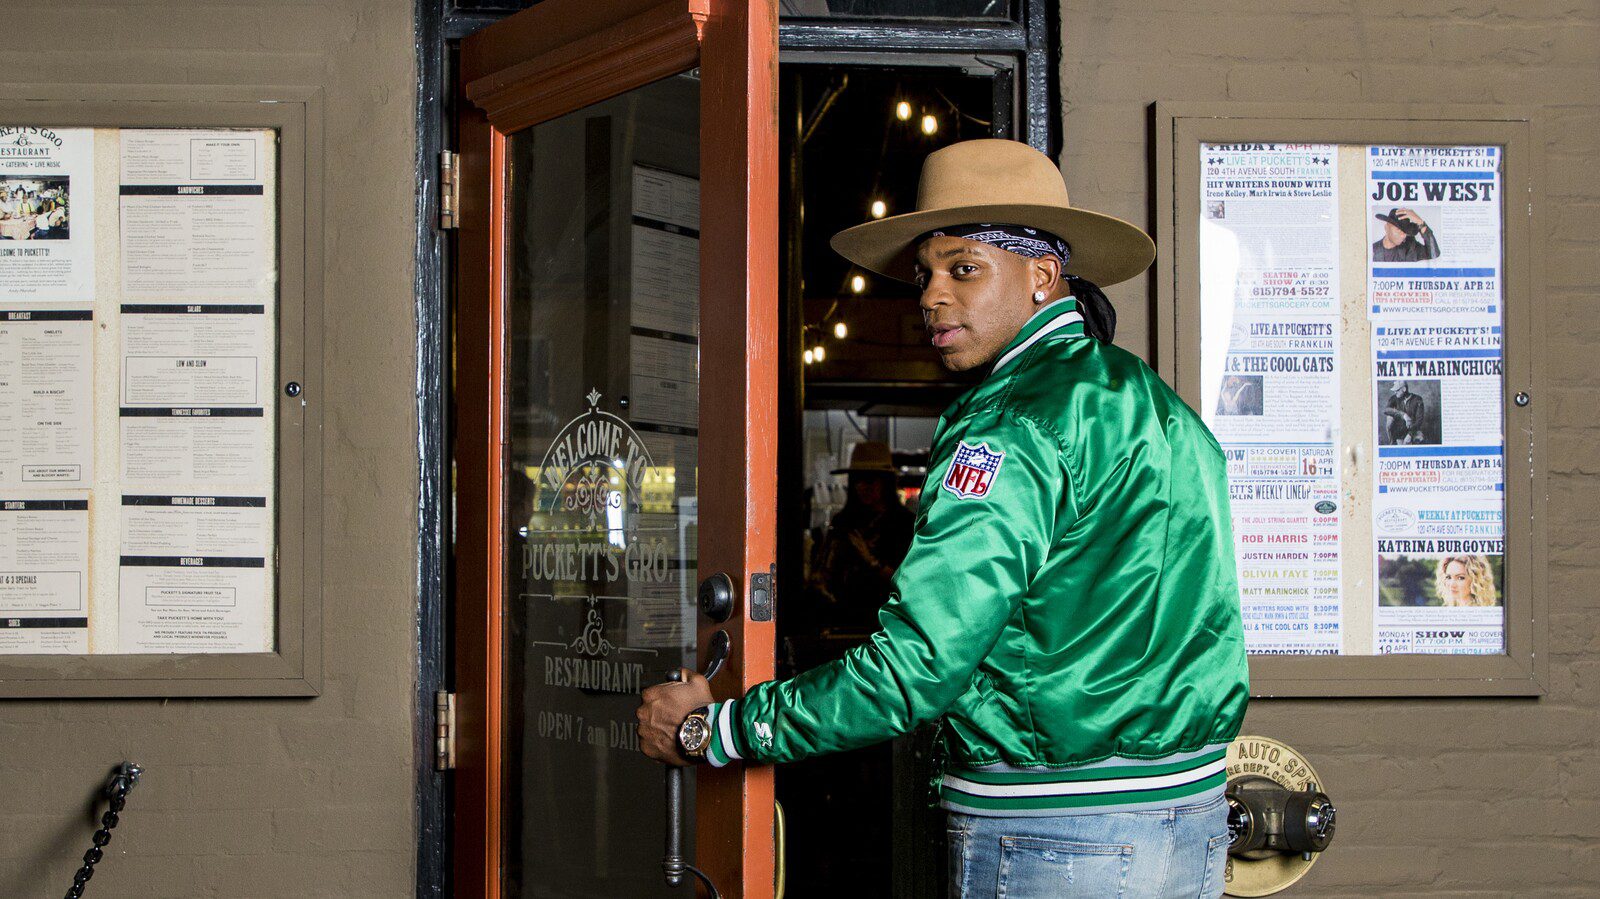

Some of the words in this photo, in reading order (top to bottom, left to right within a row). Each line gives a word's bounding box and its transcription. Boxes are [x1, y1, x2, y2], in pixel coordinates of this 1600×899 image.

[1424, 148, 1484, 156] PUCKETT'S!
[1226, 157, 1246, 166] LIVE
[1249, 157, 1258, 166] AT
[1261, 156, 1310, 166] PUCKETT'S
[1432, 159, 1494, 167] FRANKLIN
[1208, 168, 1219, 176] 120
[1221, 168, 1236, 176] 4TH
[1238, 168, 1267, 176] AVENUE
[1269, 168, 1294, 176] SOUTH
[1297, 168, 1330, 176] FRANKLIN
[1372, 182, 1418, 201] JOE
[1423, 182, 1494, 201] WEST
[17, 248, 23, 256] TO
[1373, 282, 1403, 290] 7:00PM
[1409, 281, 1459, 290] THURSDAY
[1464, 282, 1483, 290] APR
[1486, 282, 1494, 290] 21
[1253, 287, 1330, 296] 615)794-5527
[1250, 324, 1269, 335] LIVE
[1271, 324, 1284, 335] AT
[1286, 324, 1332, 335] PUCKETT'S
[1429, 326, 1488, 335] PUCKETT'S!
[1288, 340, 1332, 348] FRANKLIN
[1437, 337, 1500, 345] FRANKLIN
[1232, 357, 1240, 372] &
[1243, 357, 1268, 372] THE
[1270, 357, 1301, 372] COOL
[1302, 357, 1333, 372] CATS
[1377, 361, 1413, 376] MATT
[1416, 360, 1501, 376] MARINCHICK
[544, 420, 623, 491] WELCOME
[624, 436, 647, 489] TO
[1380, 461, 1410, 470] 7:00PM
[1472, 460, 1490, 468] APR
[1493, 460, 1501, 468] 14
[948, 464, 986, 494] NFL
[1256, 485, 1283, 500] WEEKLY
[1286, 485, 1310, 499] LINEUP
[1418, 511, 1449, 520] WEEKLY
[1451, 511, 1461, 520] AT
[1462, 511, 1502, 520] PUCKETT'S
[1437, 525, 1445, 534] AVE
[1446, 525, 1462, 534] SOUTH
[1465, 525, 1501, 534] FRANKLIN
[1378, 540, 1434, 552] KATRINA
[1438, 540, 1503, 552] BURGOYNE
[522, 542, 619, 582] PUCKETT'S
[624, 542, 672, 582] GRO.
[1243, 570, 1278, 578] OLIVIA
[1283, 570, 1308, 578] FAYE
[544, 656, 643, 695] RESTAURANT
[538, 710, 572, 740] OPEN
[576, 716, 584, 742] 7
[1239, 742, 1281, 766] AUTO.
[1227, 764, 1242, 778] RE
[1243, 762, 1270, 776] DEPT.
